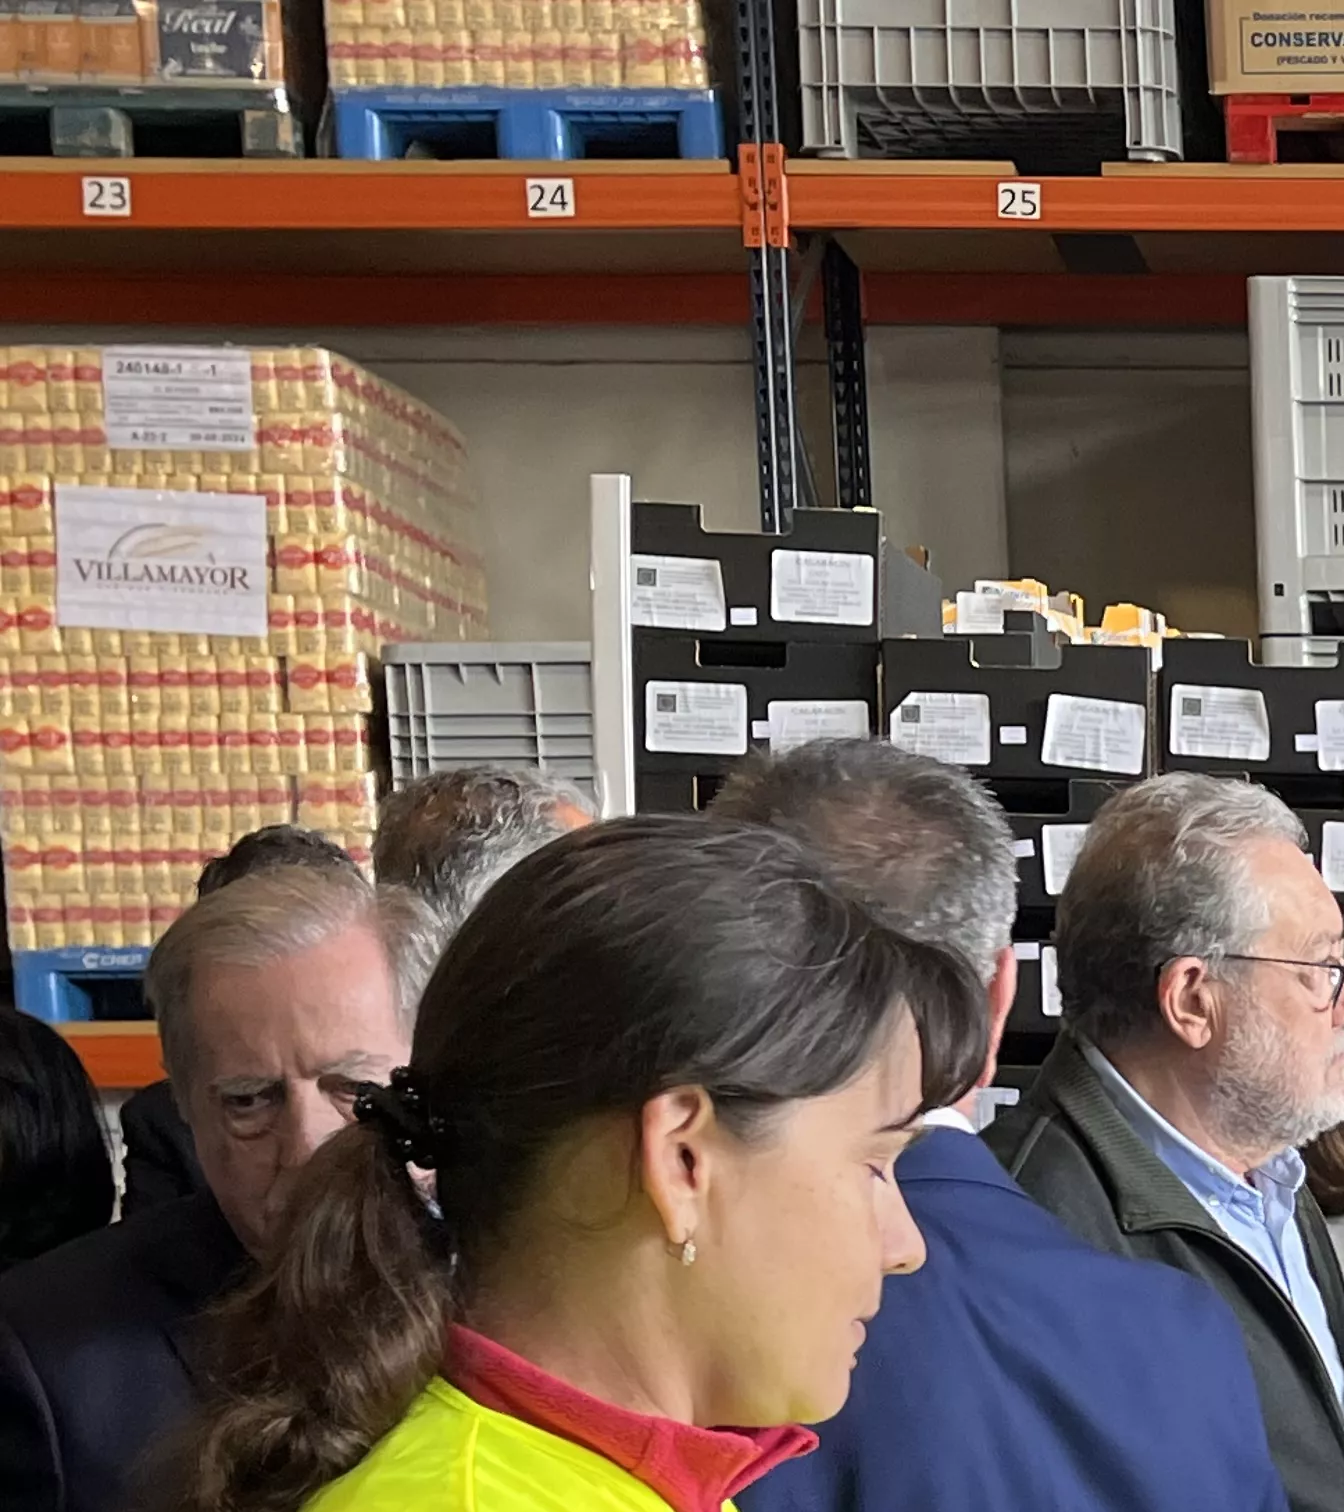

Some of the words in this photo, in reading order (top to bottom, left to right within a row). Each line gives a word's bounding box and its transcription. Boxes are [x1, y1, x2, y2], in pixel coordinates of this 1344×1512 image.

[87, 181, 128, 210] 23
[529, 184, 569, 212] 24
[1000, 189, 1038, 218] 25
[73, 557, 251, 590] VILLAMAYOR
